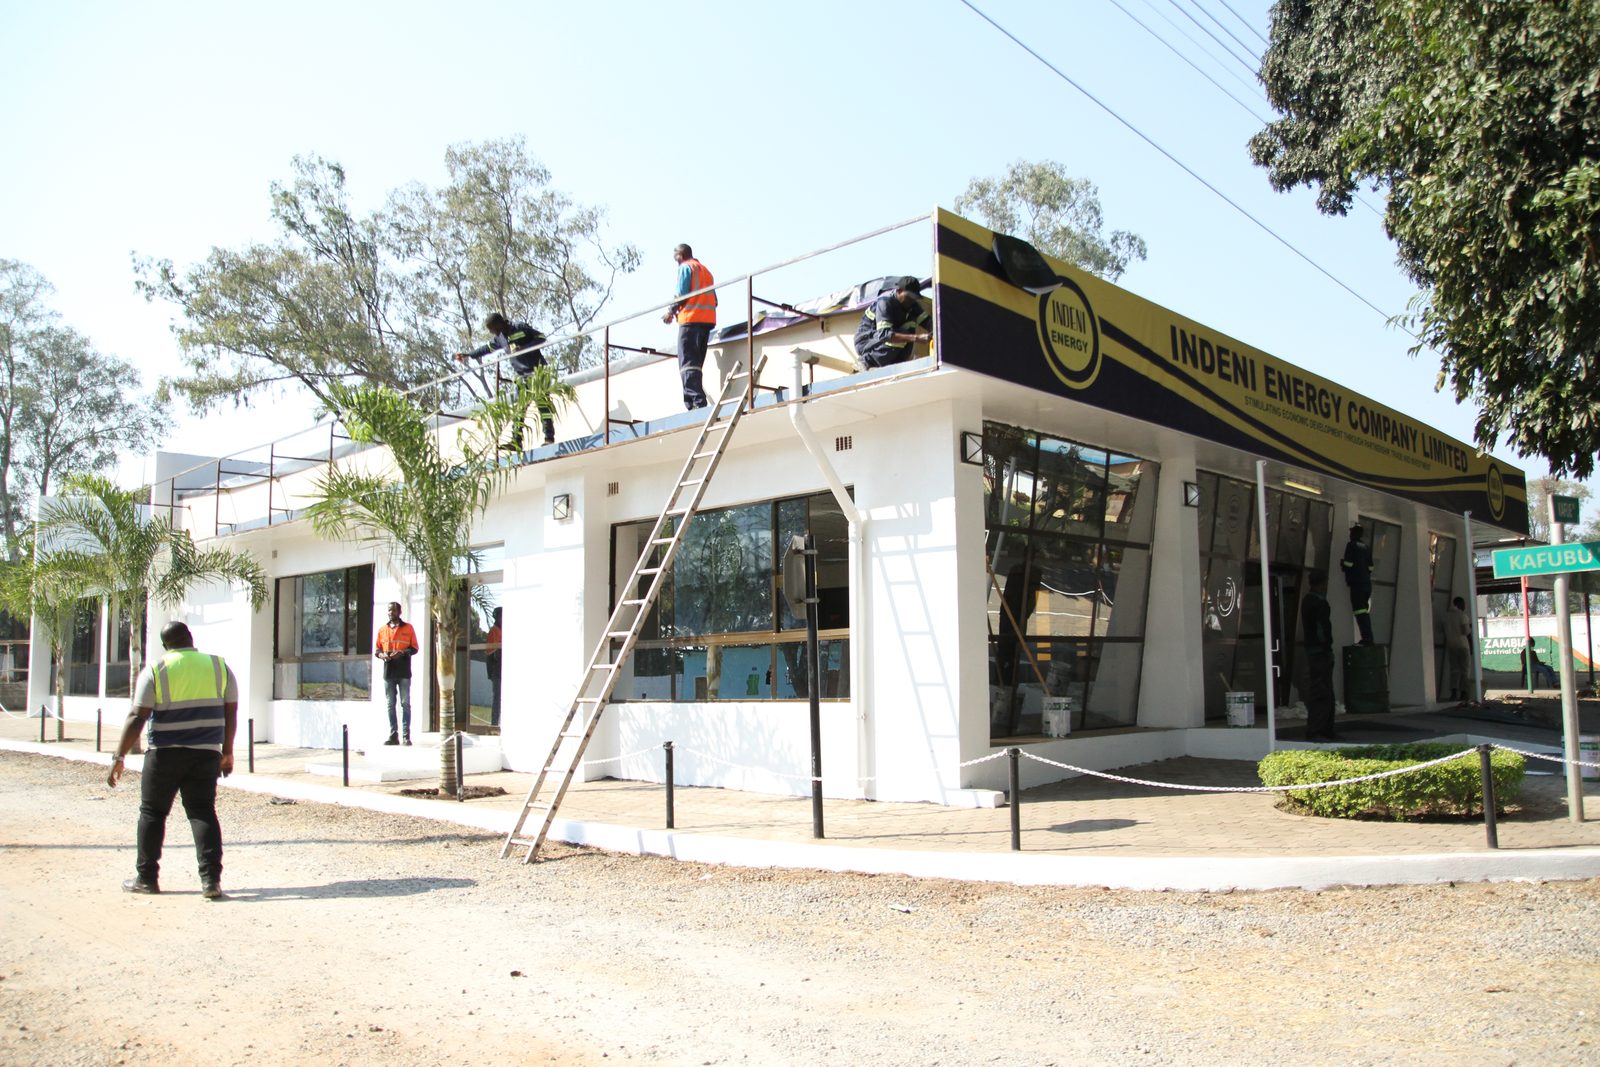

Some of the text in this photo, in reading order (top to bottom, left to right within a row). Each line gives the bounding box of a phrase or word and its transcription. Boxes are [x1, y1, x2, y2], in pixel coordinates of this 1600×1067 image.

[1052, 299, 1086, 335] INDENI
[1051, 329, 1088, 353] ENERGY
[1170, 324, 1468, 473] INDENI ENERGY COMPANY LIMITED
[1508, 548, 1593, 571] KAFUBU
[1484, 638, 1528, 649] ZAMBIA
